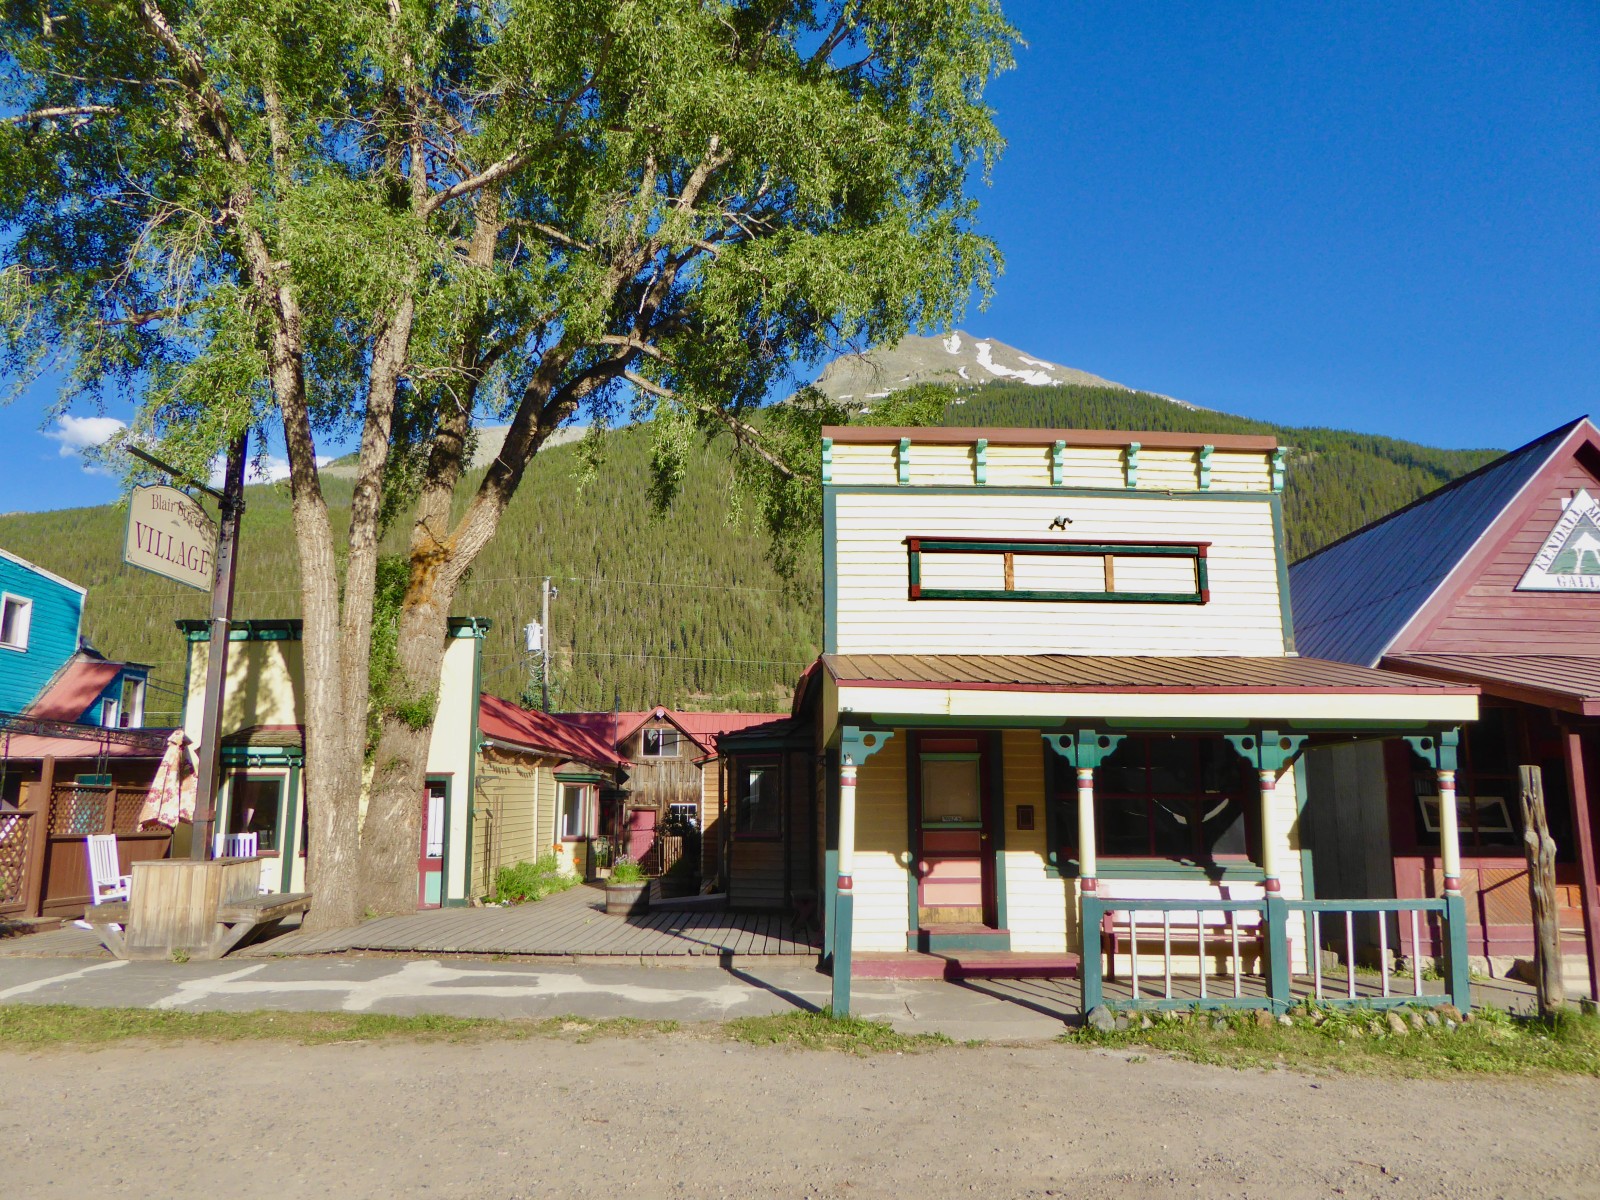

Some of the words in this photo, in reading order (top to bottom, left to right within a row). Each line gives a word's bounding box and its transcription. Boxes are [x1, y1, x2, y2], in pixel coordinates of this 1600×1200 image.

[151, 494, 176, 512] Blair
[136, 520, 210, 576] VILLAGE
[1534, 508, 1583, 572] KENDALL
